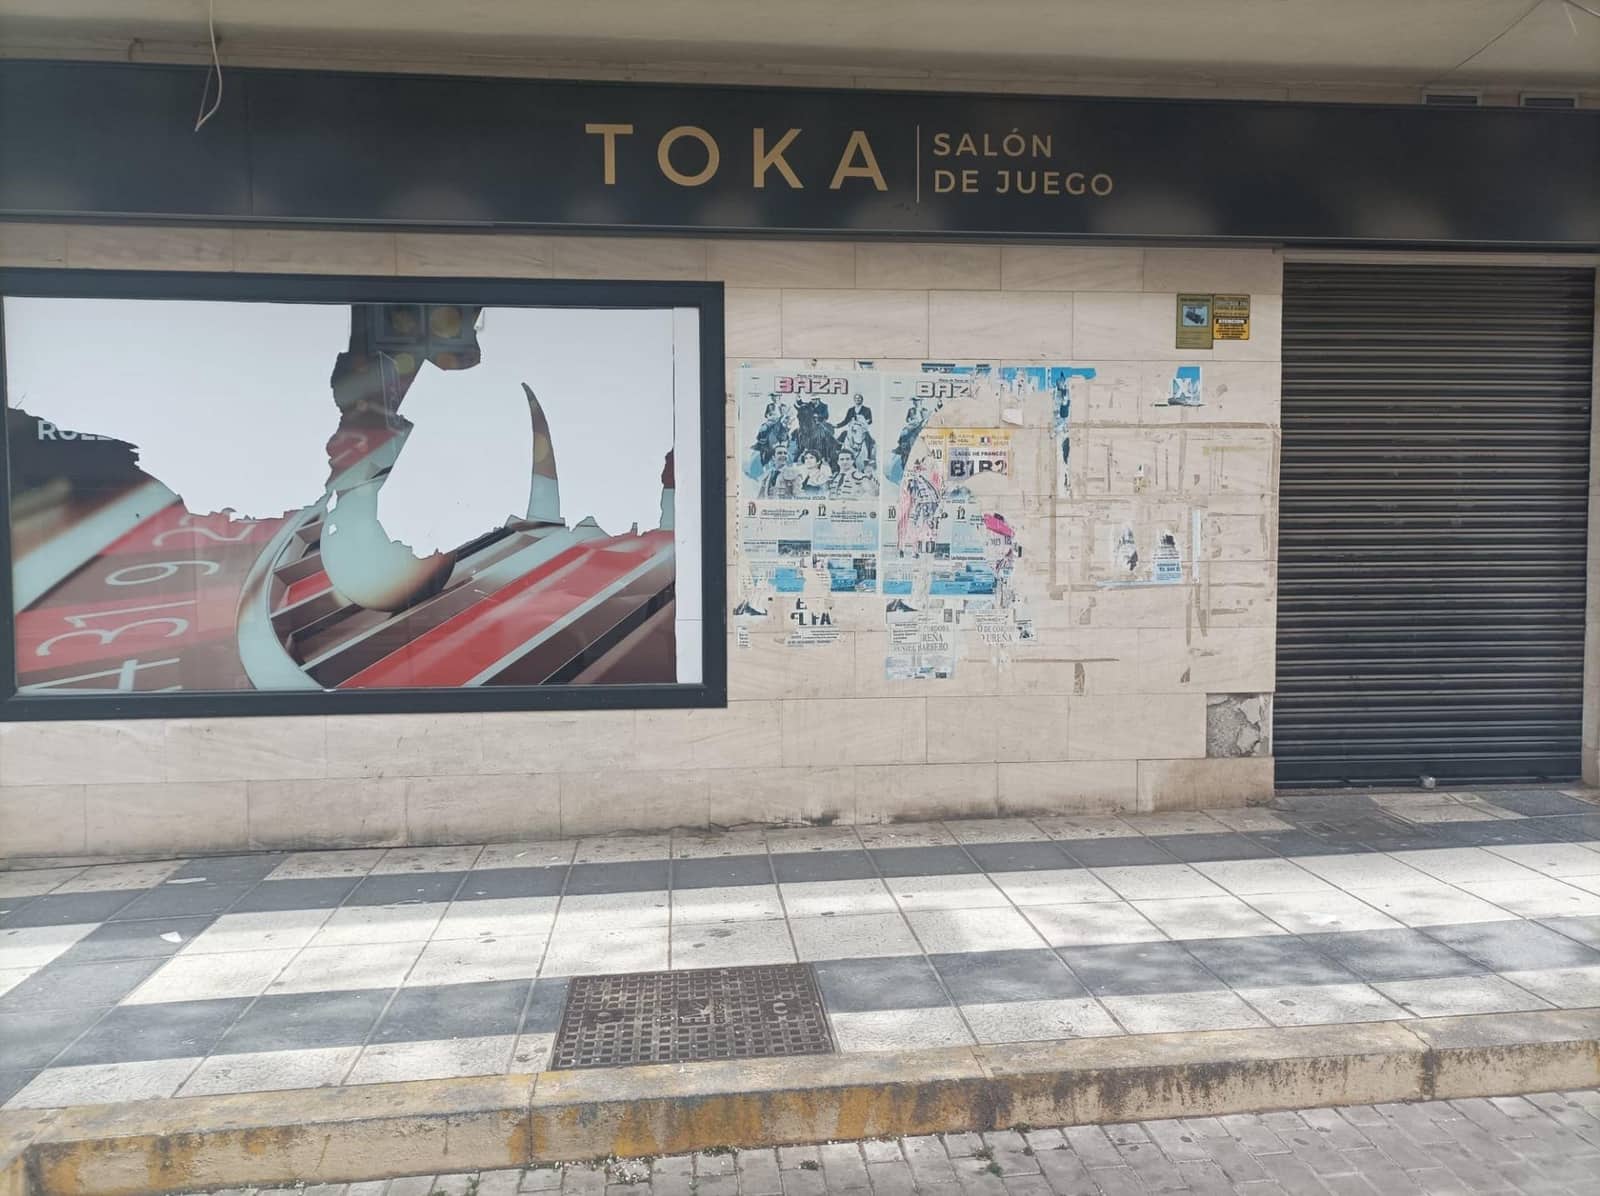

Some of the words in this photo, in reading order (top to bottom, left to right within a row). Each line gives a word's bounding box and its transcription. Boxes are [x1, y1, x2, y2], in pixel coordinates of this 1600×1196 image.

[586, 123, 888, 192] TOKA
[933, 128, 1053, 158] SALÓN
[933, 169, 980, 194] DE
[995, 169, 1114, 197] JUEGO
[774, 376, 849, 395] BAZA
